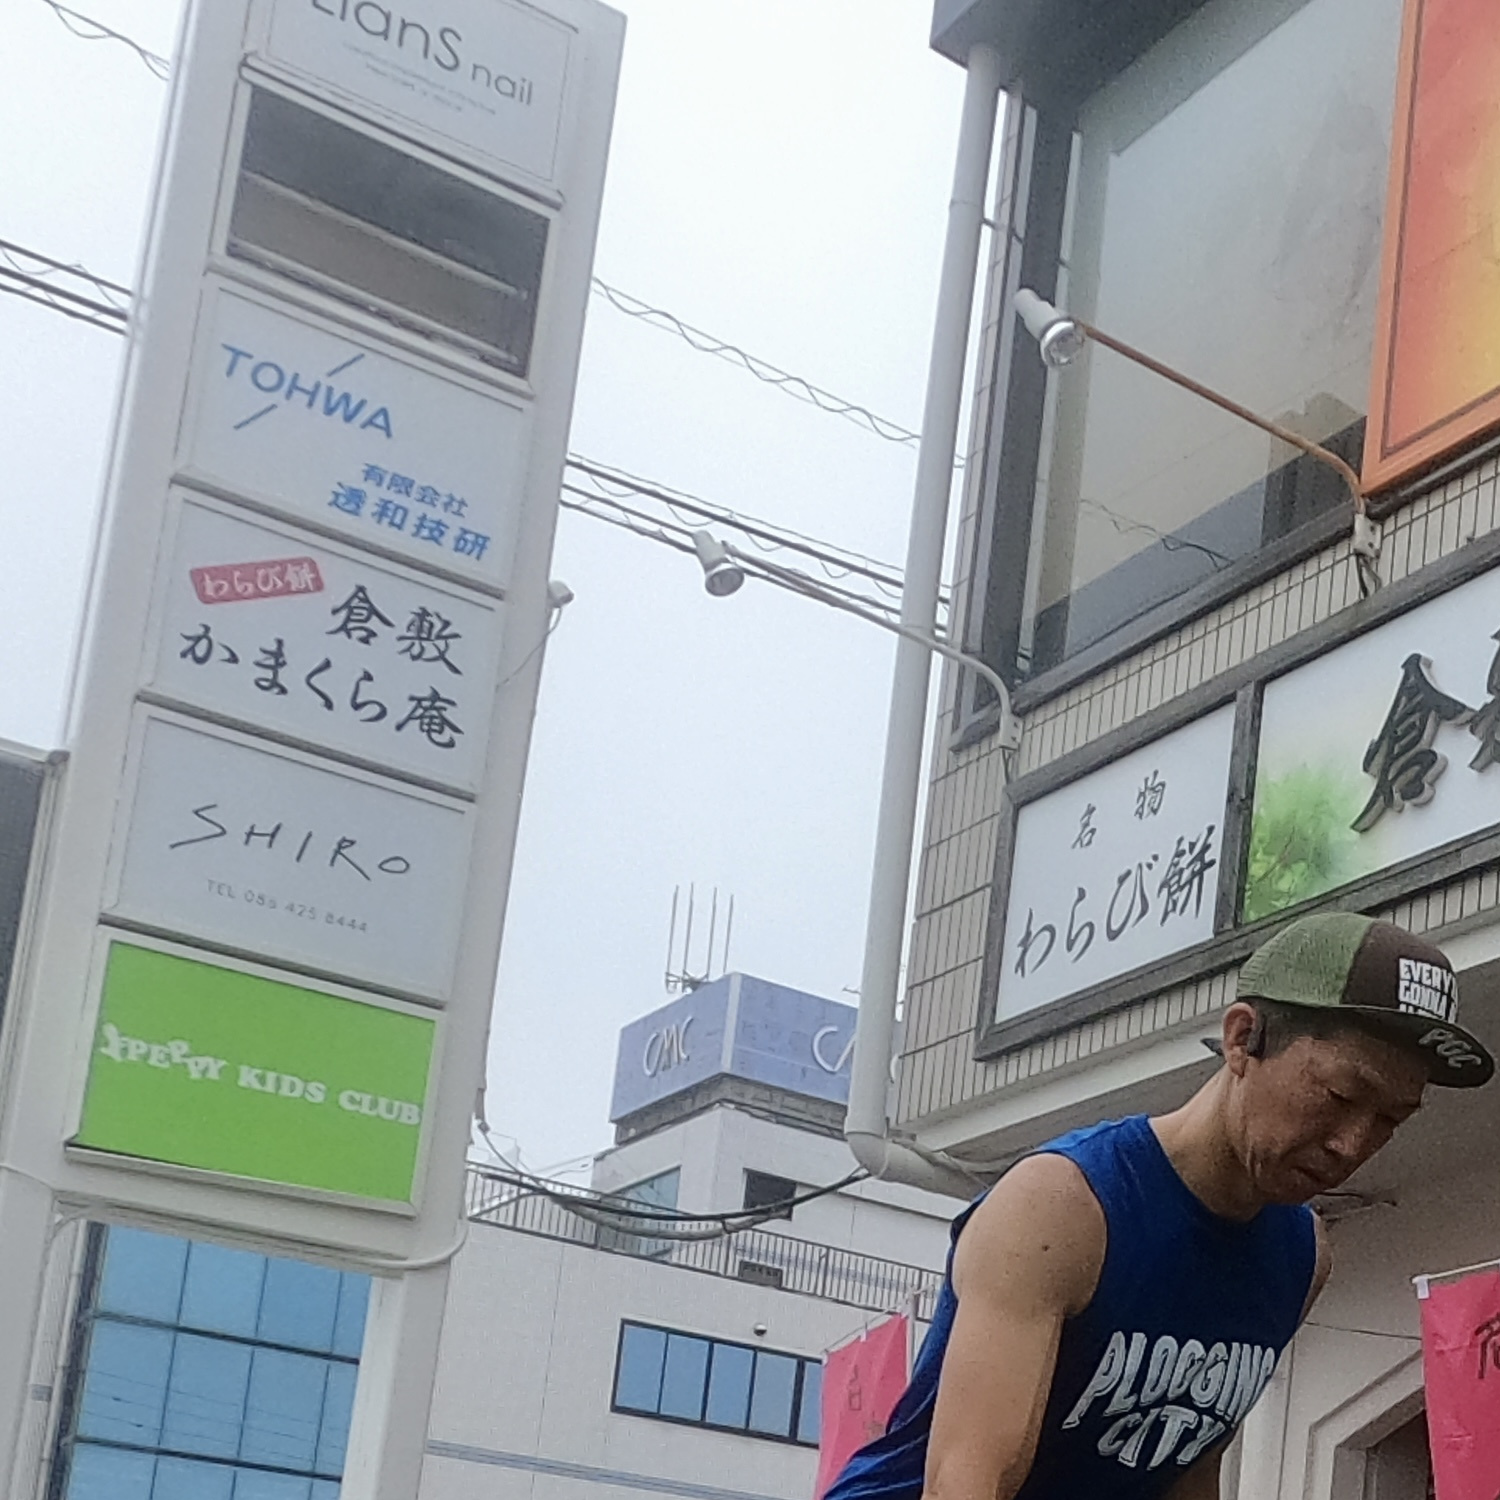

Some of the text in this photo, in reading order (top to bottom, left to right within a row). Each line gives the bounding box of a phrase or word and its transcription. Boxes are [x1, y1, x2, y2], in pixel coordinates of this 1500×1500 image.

[471, 63, 533, 105] nail
[221, 343, 394, 438] TOHWA
[360, 462, 469, 518] 有限会社
[201, 561, 318, 599] わらび餅
[326, 584, 463, 676] 倉敷
[179, 623, 465, 750] かまくら庵
[169, 804, 410, 881] SHIRO
[1071, 769, 1167, 850] 名物
[207, 878, 237, 899] TEL
[284, 902, 317, 920] 425
[1015, 824, 1217, 978] わらび餅
[237, 1064, 328, 1104] KIDS
[338, 1089, 423, 1126] CLUB
[1097, 1404, 1227, 1471] CITY
